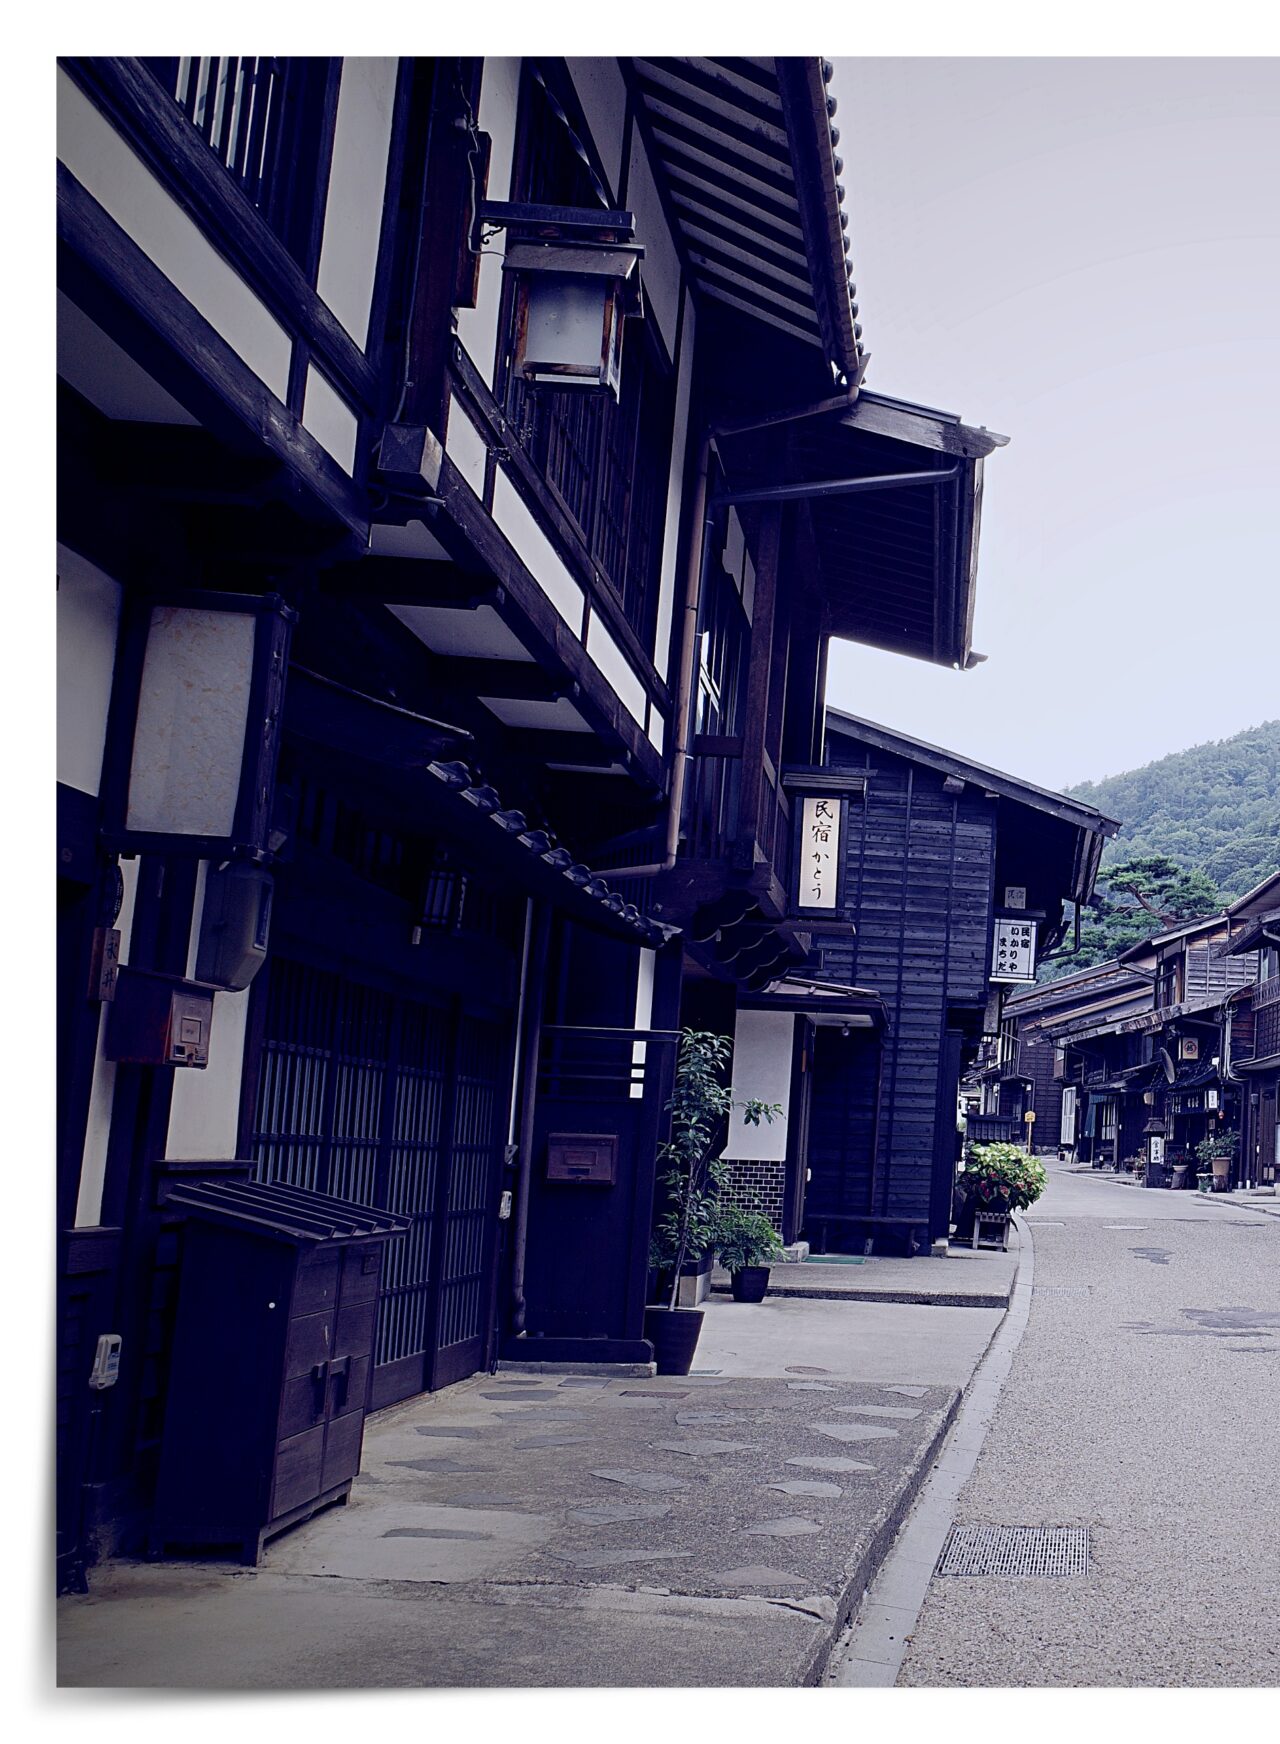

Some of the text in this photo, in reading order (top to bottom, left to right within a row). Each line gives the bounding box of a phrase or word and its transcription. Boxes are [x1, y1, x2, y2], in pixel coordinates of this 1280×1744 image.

[998, 937, 1008, 971] まちだ
[1008, 927, 1020, 972] いかりや
[1020, 927, 1030, 949] 民宿
